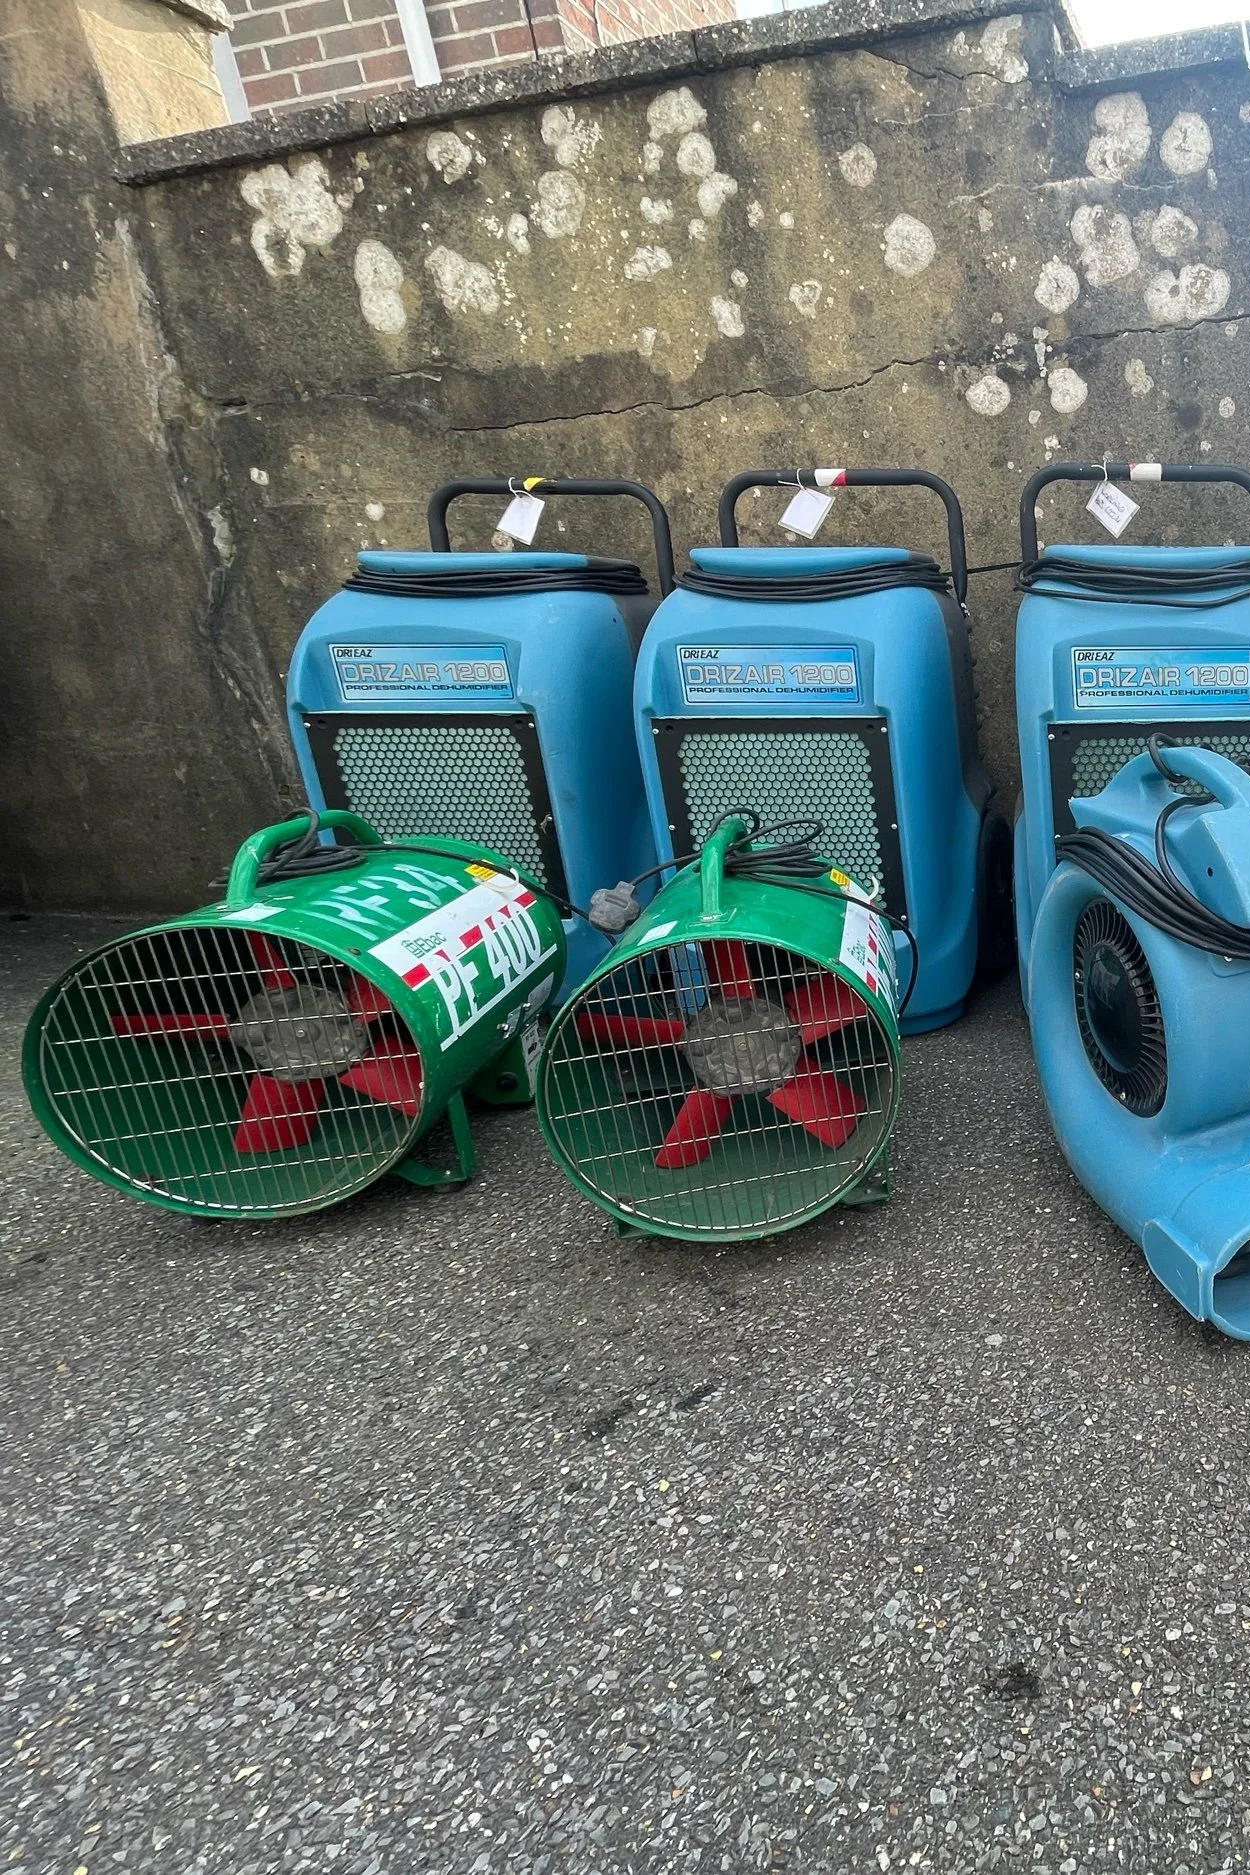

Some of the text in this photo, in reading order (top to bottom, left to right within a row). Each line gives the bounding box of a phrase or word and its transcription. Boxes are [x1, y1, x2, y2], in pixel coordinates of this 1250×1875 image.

[341, 663, 507, 682] DRIZAIR 1200
[686, 664, 853, 685] DRIZAIR 1200
[1079, 665, 1249, 688] DRIZAIR 1200
[430, 900, 542, 1036] PF 400
